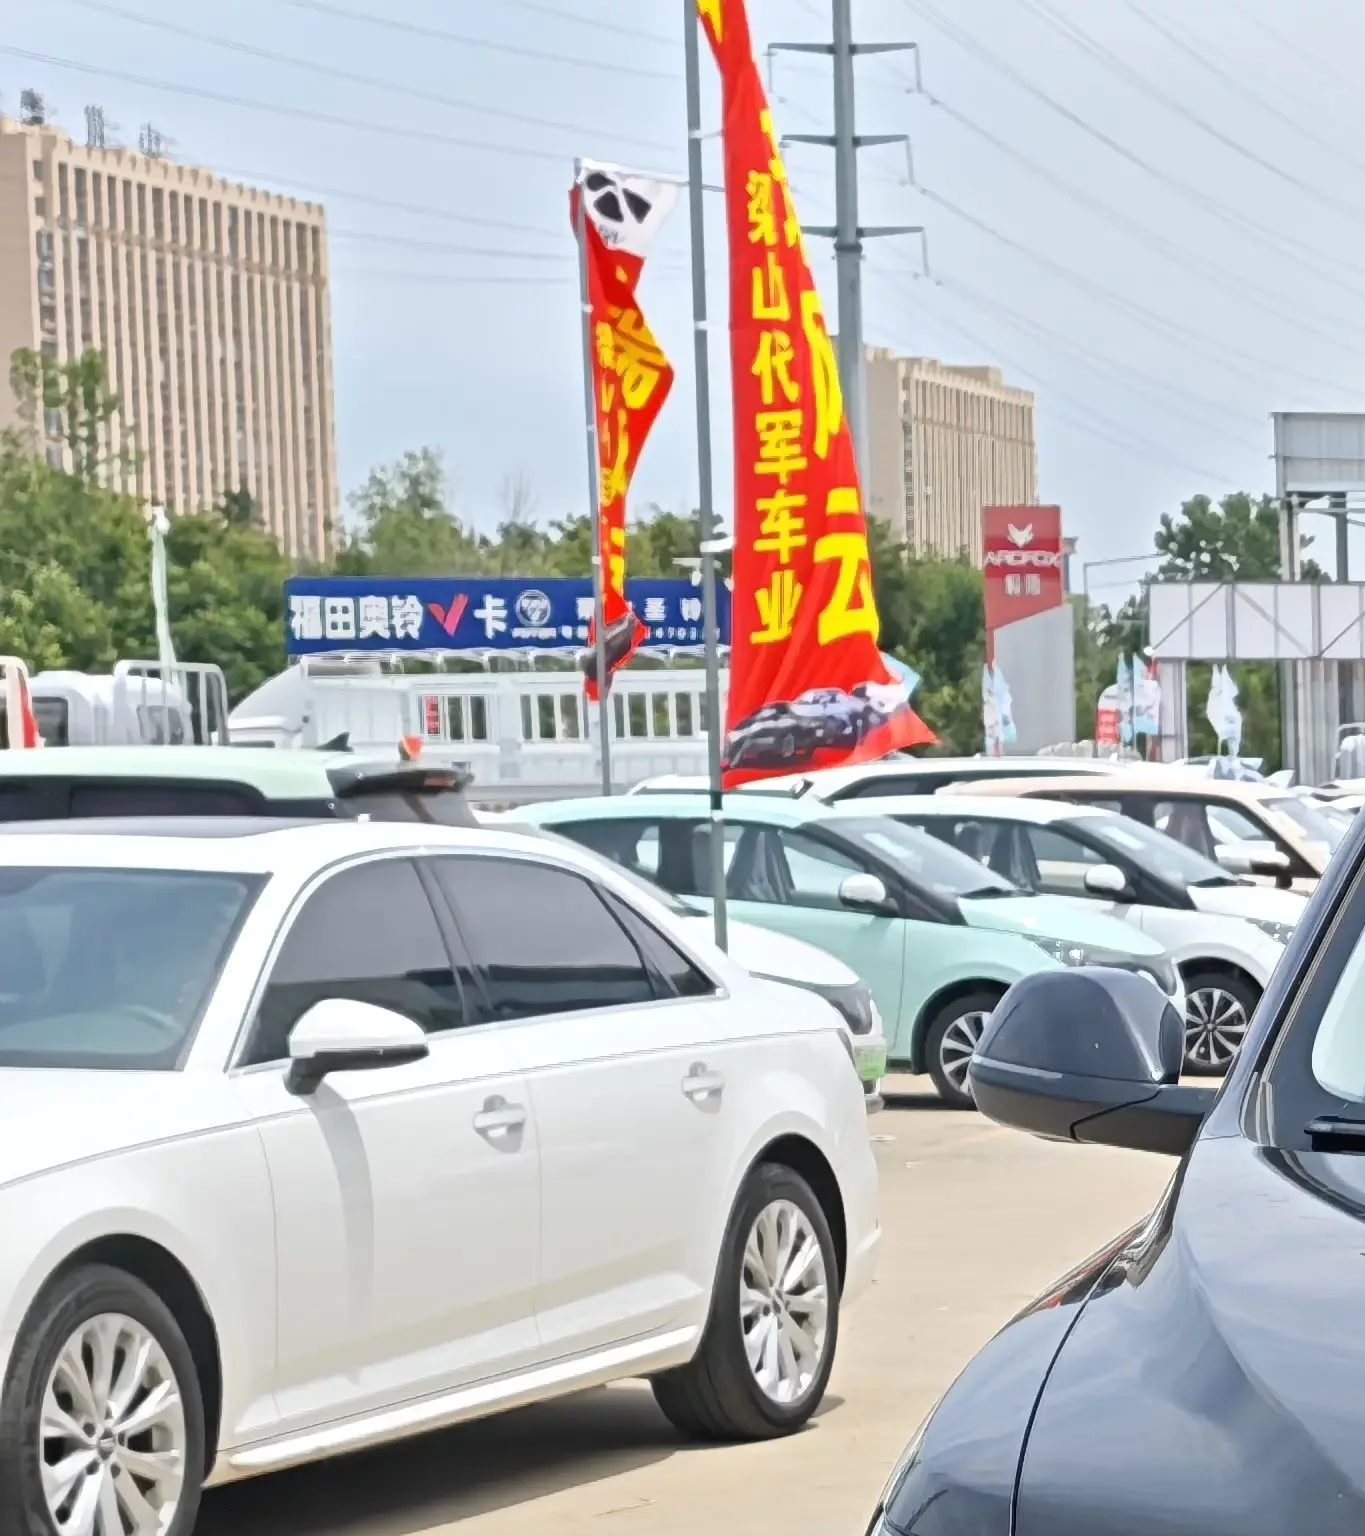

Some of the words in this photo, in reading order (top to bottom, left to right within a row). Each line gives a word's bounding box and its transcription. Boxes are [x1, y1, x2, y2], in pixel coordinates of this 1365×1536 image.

[745, 169, 808, 645] 梁山代军车业
